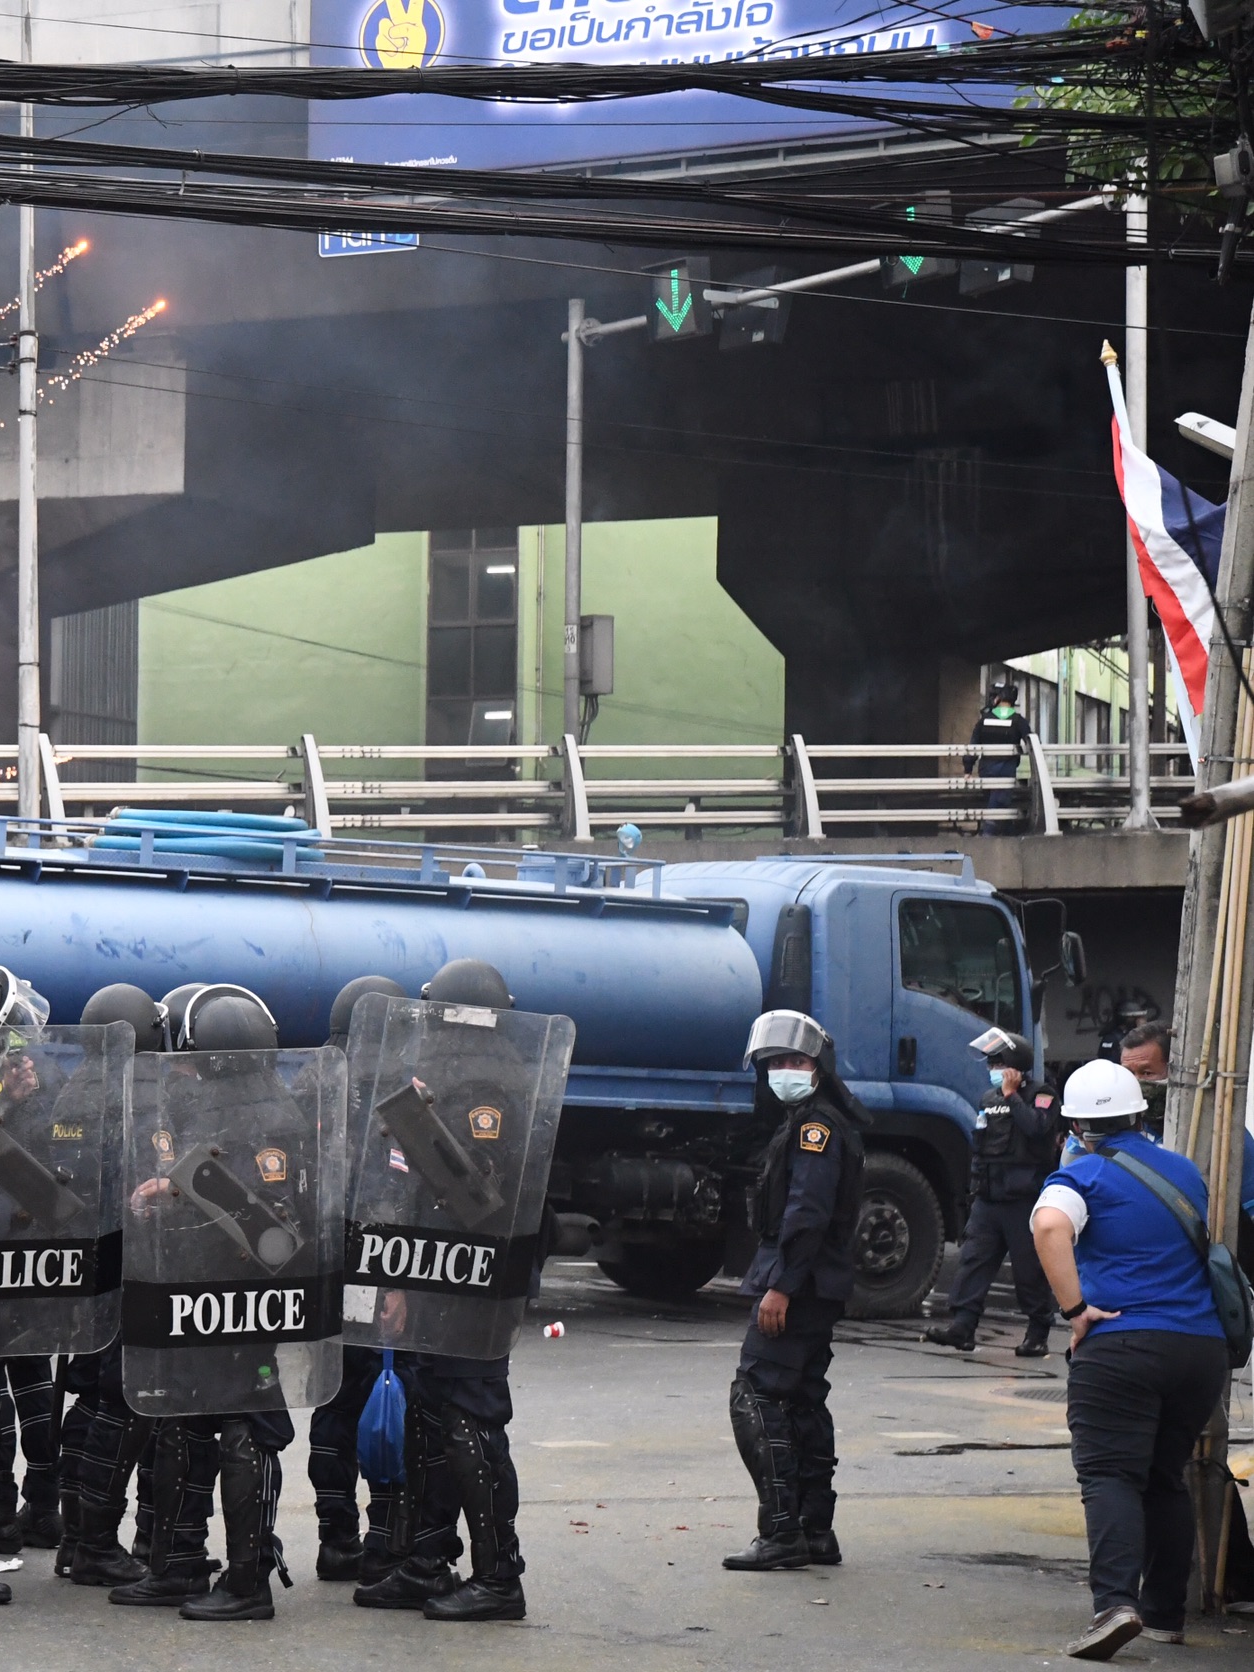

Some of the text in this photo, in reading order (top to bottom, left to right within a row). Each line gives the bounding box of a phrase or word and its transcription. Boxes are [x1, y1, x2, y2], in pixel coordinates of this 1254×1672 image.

[53, 1124, 83, 1138] POLICE
[356, 1233, 496, 1287] POLICE
[169, 1289, 306, 1336] POLICE
